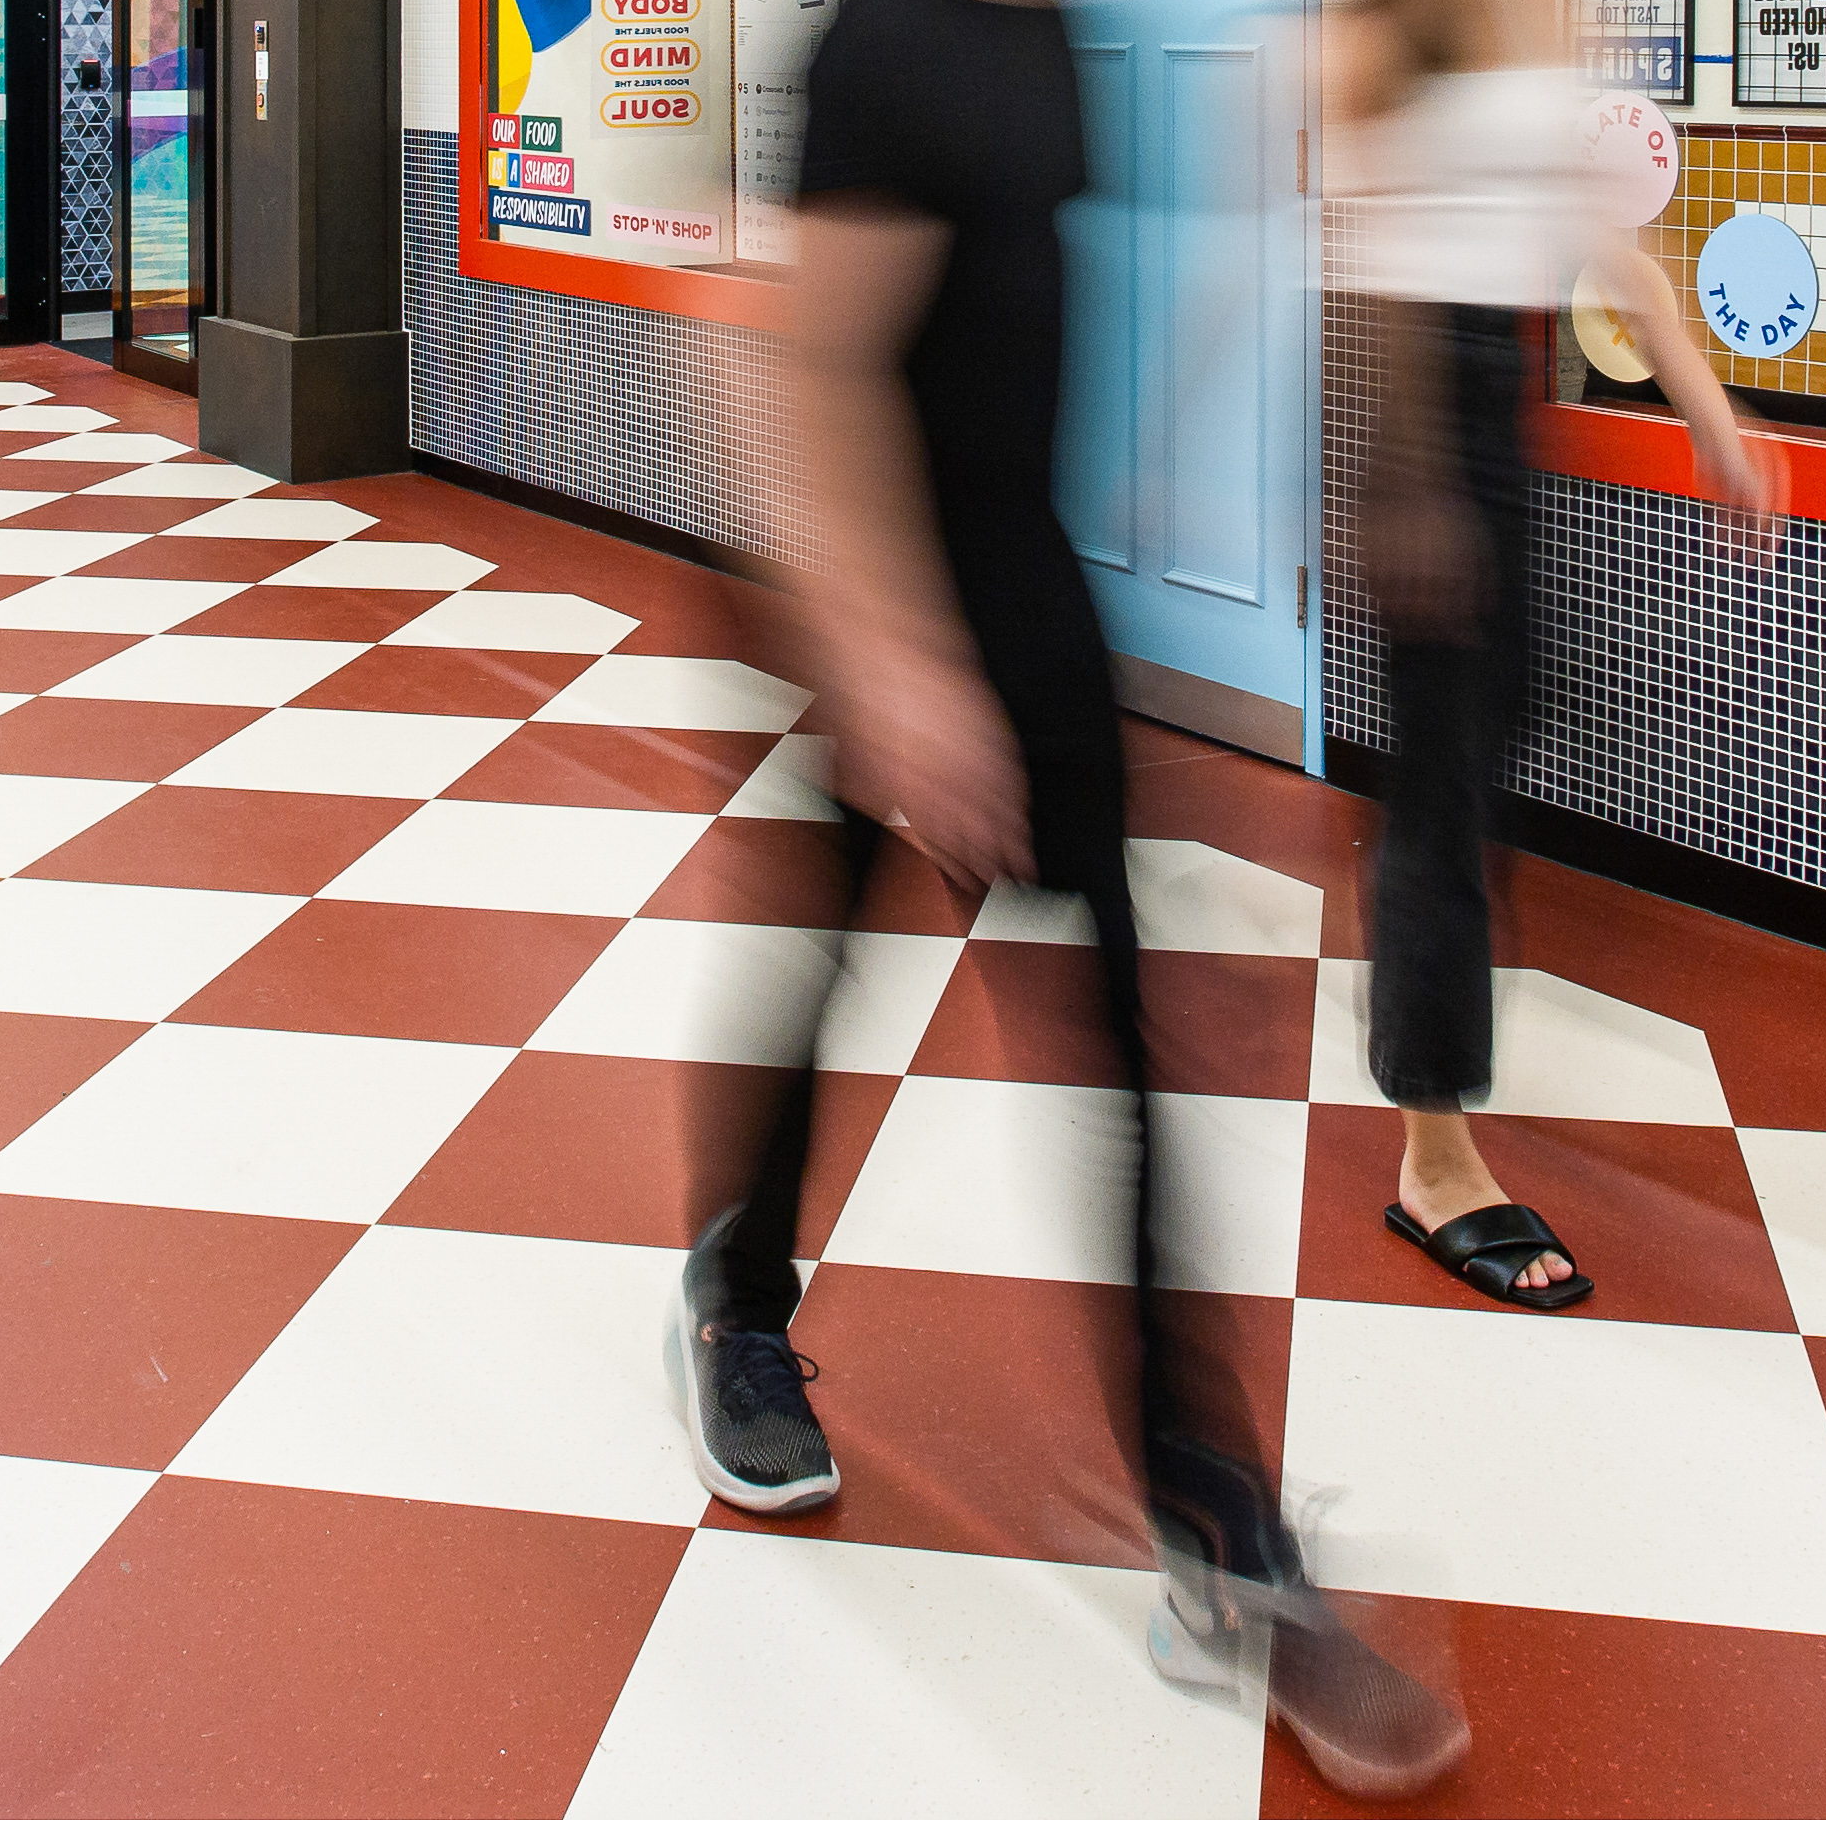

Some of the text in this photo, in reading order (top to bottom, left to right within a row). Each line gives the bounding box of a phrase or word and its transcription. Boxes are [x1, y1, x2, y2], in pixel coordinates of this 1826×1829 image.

[743, 83, 749, 95] 5
[743, 105, 749, 116] 4
[492, 118, 556, 146] OUR FOOD
[743, 127, 749, 138] 3
[743, 149, 749, 161] 2
[1647, 129, 1668, 170] OF
[491, 156, 571, 188] IS A SHARED
[492, 195, 587, 230] RESPONSIBILITY
[613, 214, 649, 233] STOP
[672, 221, 713, 241] SHOP
[1708, 282, 1806, 346] THE DAY
